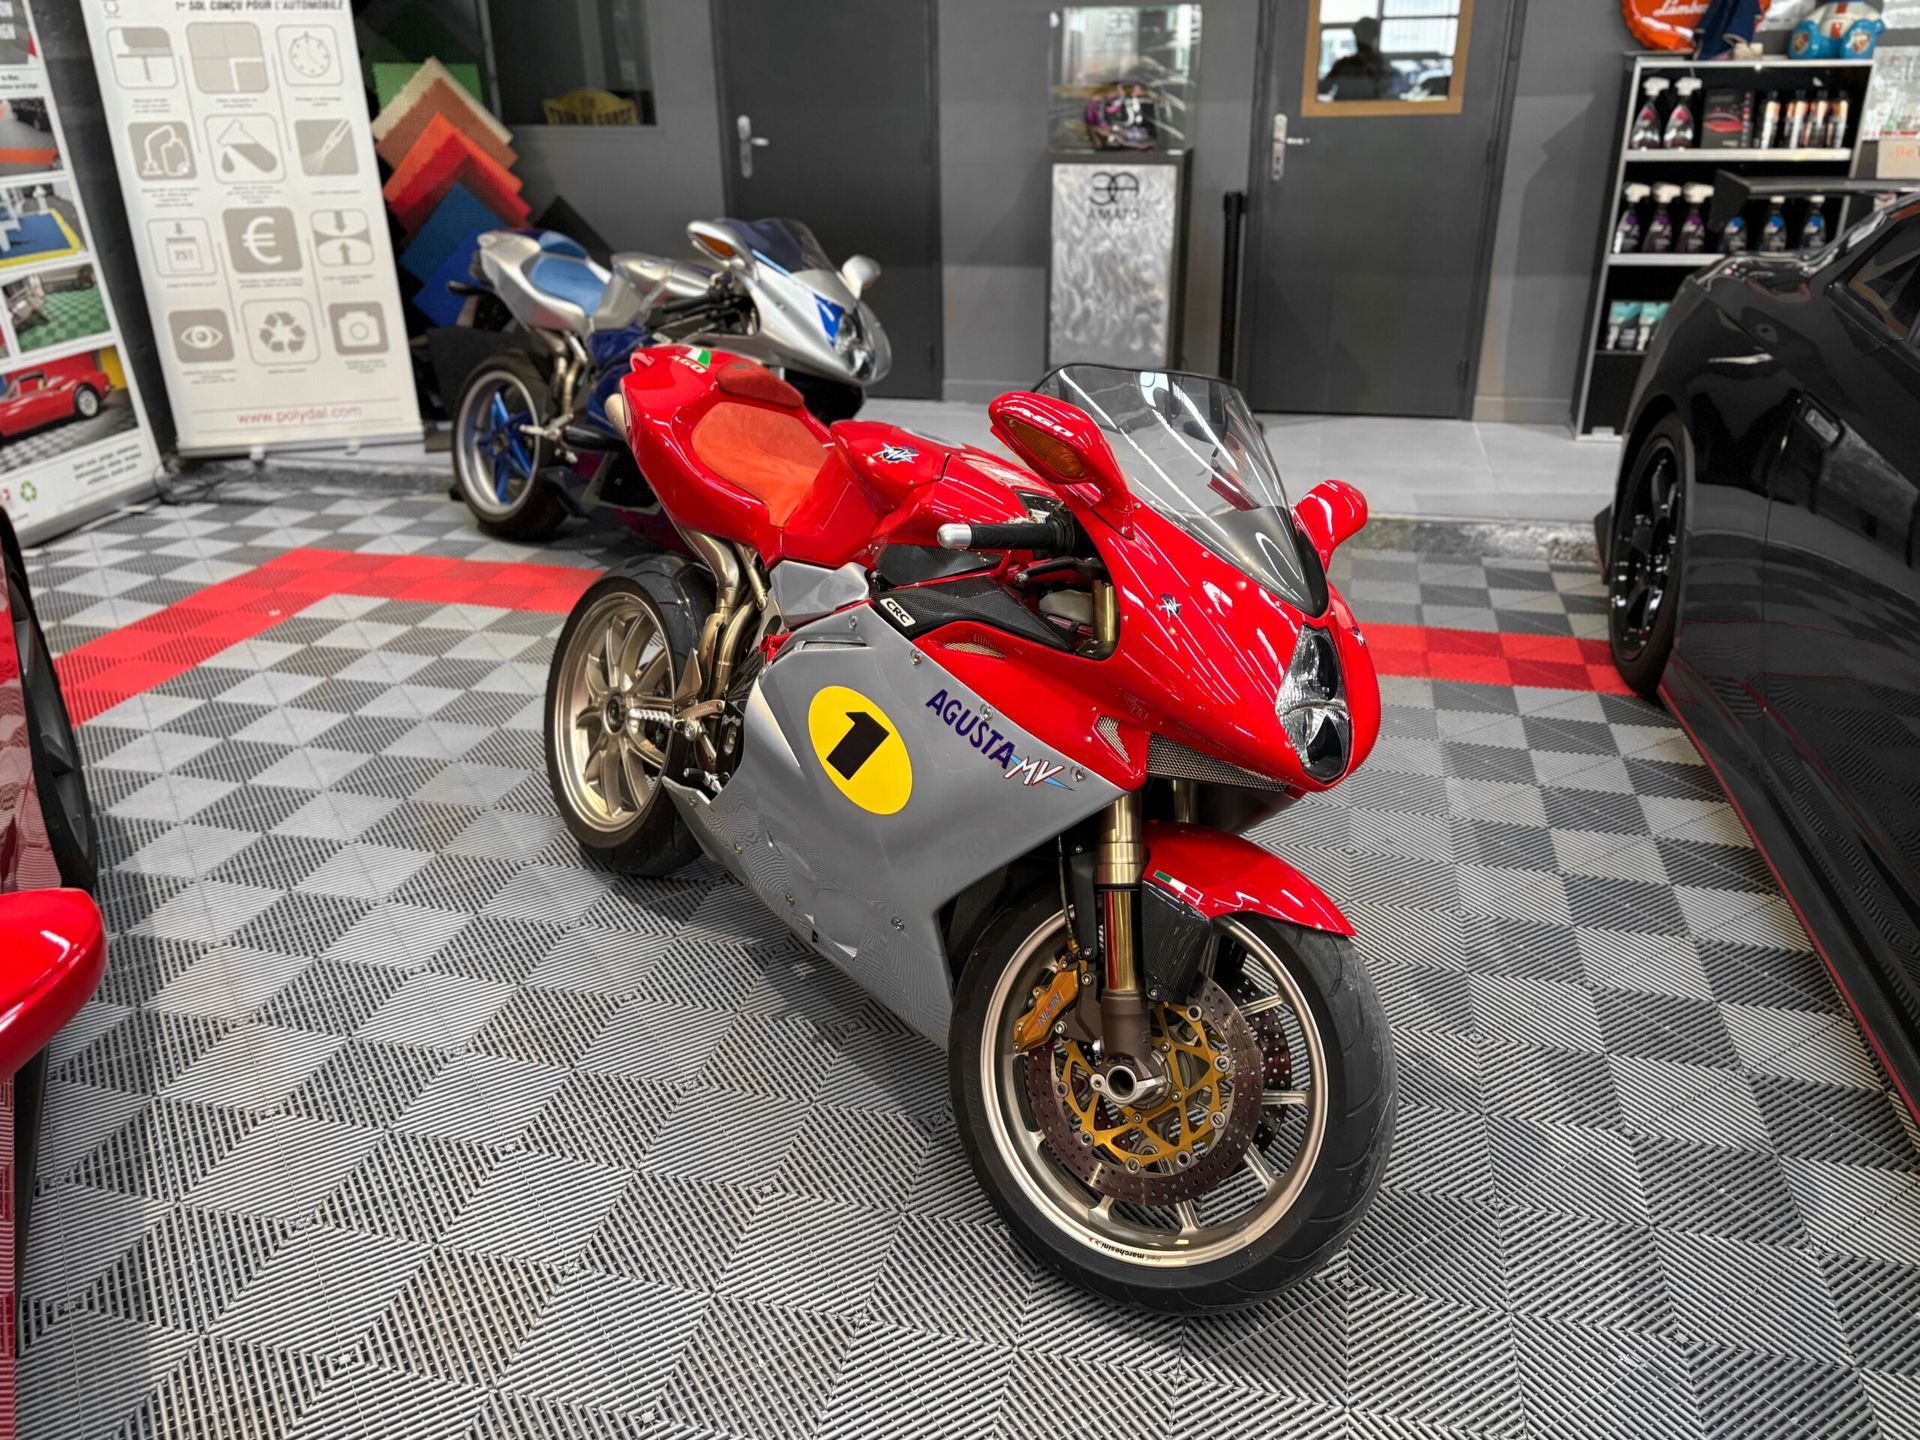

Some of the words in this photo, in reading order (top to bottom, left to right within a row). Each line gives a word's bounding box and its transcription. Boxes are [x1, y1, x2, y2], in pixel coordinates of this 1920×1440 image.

[189, 0, 206, 11] SOL
[210, 0, 242, 12] CONÇU
[246, 0, 271, 10] POUR
[275, 0, 343, 10] L'AUTOMOBILE
[237, 404, 363, 425] www.polydal.com
[886, 600, 910, 624] CRC
[826, 711, 890, 781] 1
[925, 688, 1016, 770] AGUSTA
[1003, 755, 1066, 787] MV
[1101, 1241, 1145, 1260] marchesini
